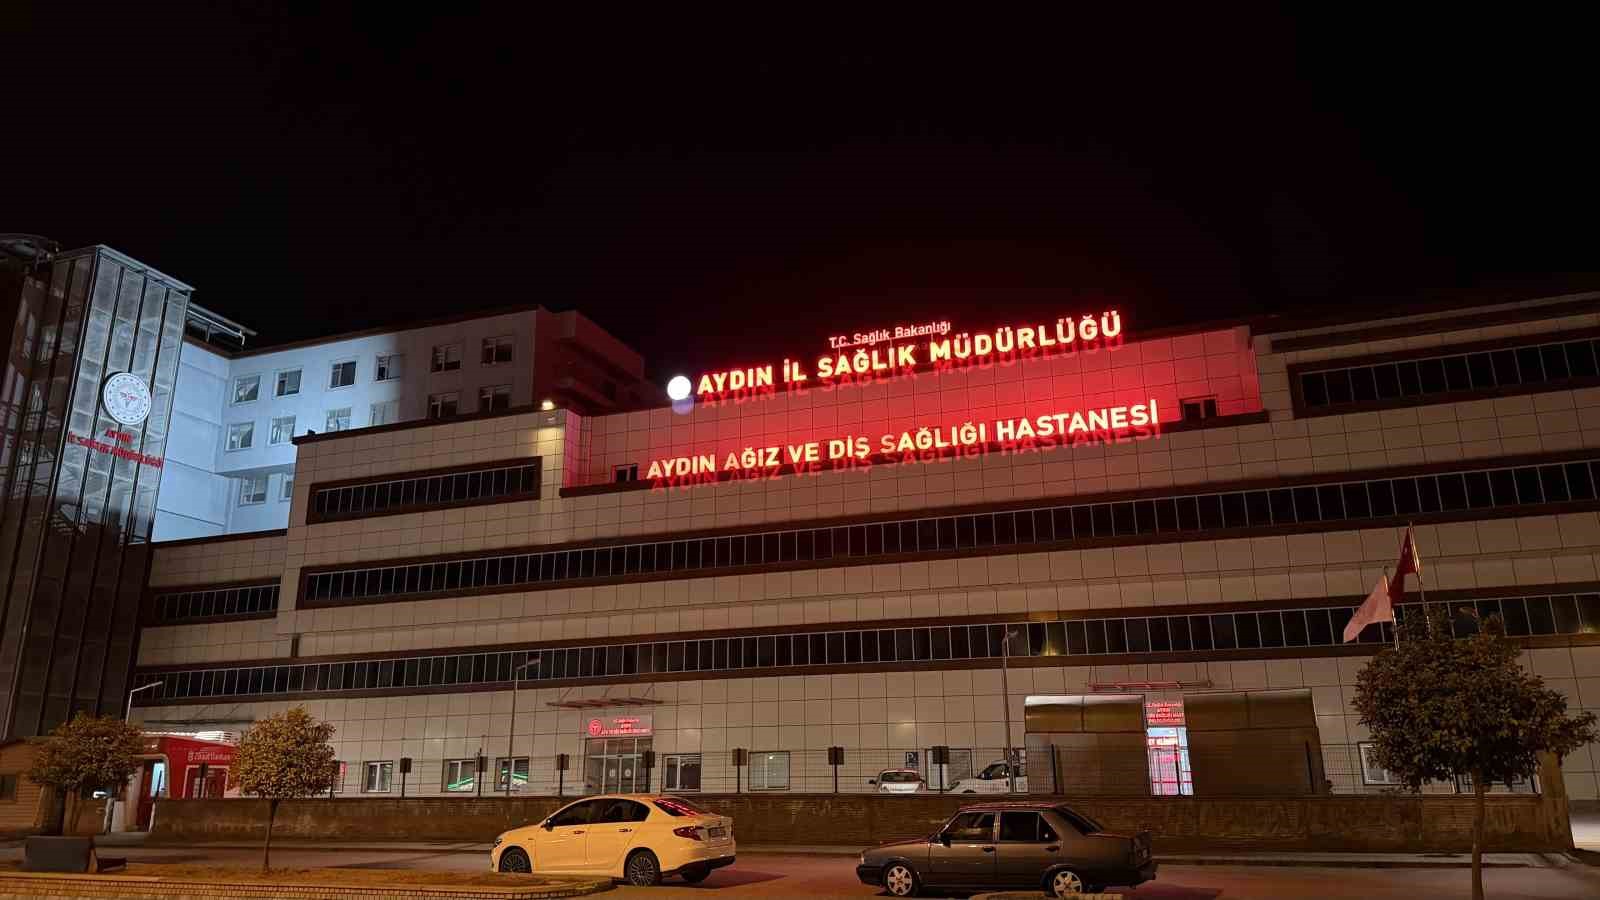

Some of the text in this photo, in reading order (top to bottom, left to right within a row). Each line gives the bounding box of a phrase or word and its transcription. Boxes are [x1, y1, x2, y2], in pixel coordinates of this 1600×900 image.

[697, 310, 1122, 394] AYDIN İL SAĞLIK MÜDÜRLÜĞÜ
[853, 329, 890, 346] Sağlık
[895, 320, 951, 339] Bakanlığı
[646, 399, 1159, 480] AYDIN AĞIZ VE DİŞ SAĞLIĞI HASTANESİ
